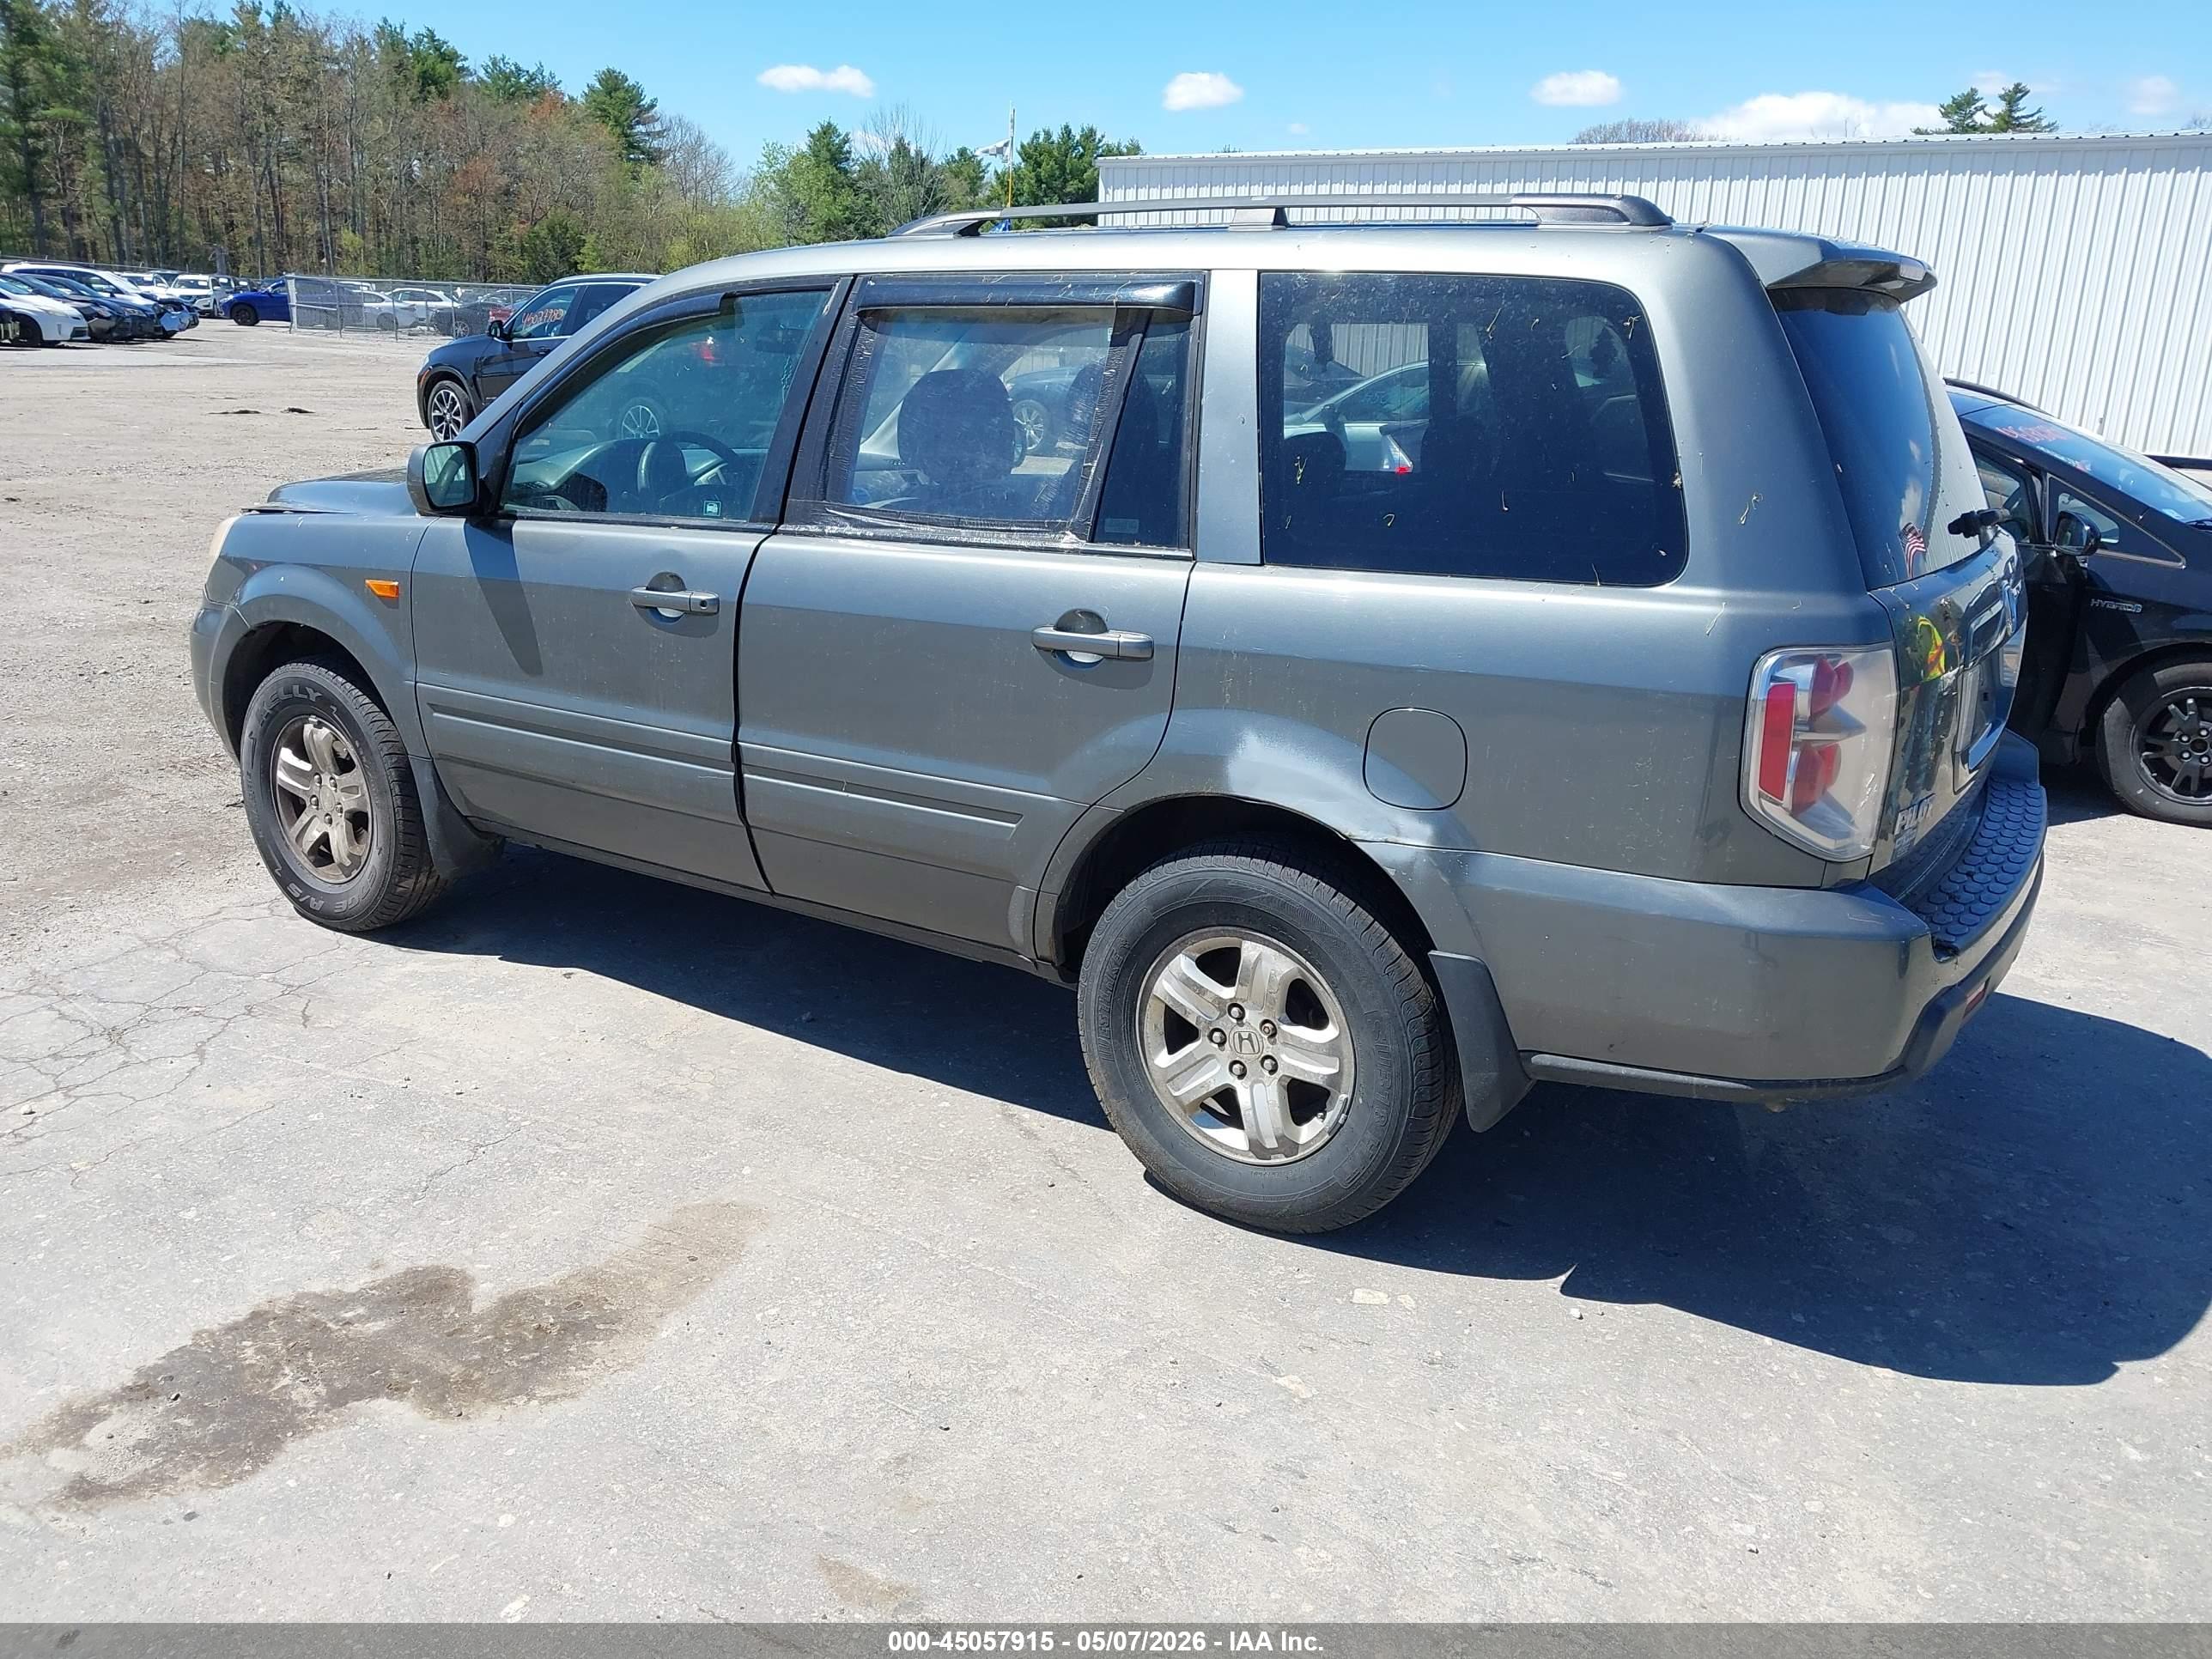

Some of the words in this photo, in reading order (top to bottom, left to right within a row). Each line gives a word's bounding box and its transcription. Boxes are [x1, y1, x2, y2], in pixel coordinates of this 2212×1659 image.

[2090, 599, 2135, 612] HYBRID
[260, 684, 323, 726] KELLY
[1894, 796, 1936, 836] PILOT
[286, 882, 325, 911] A/S
[333, 865, 378, 914] EDGE
